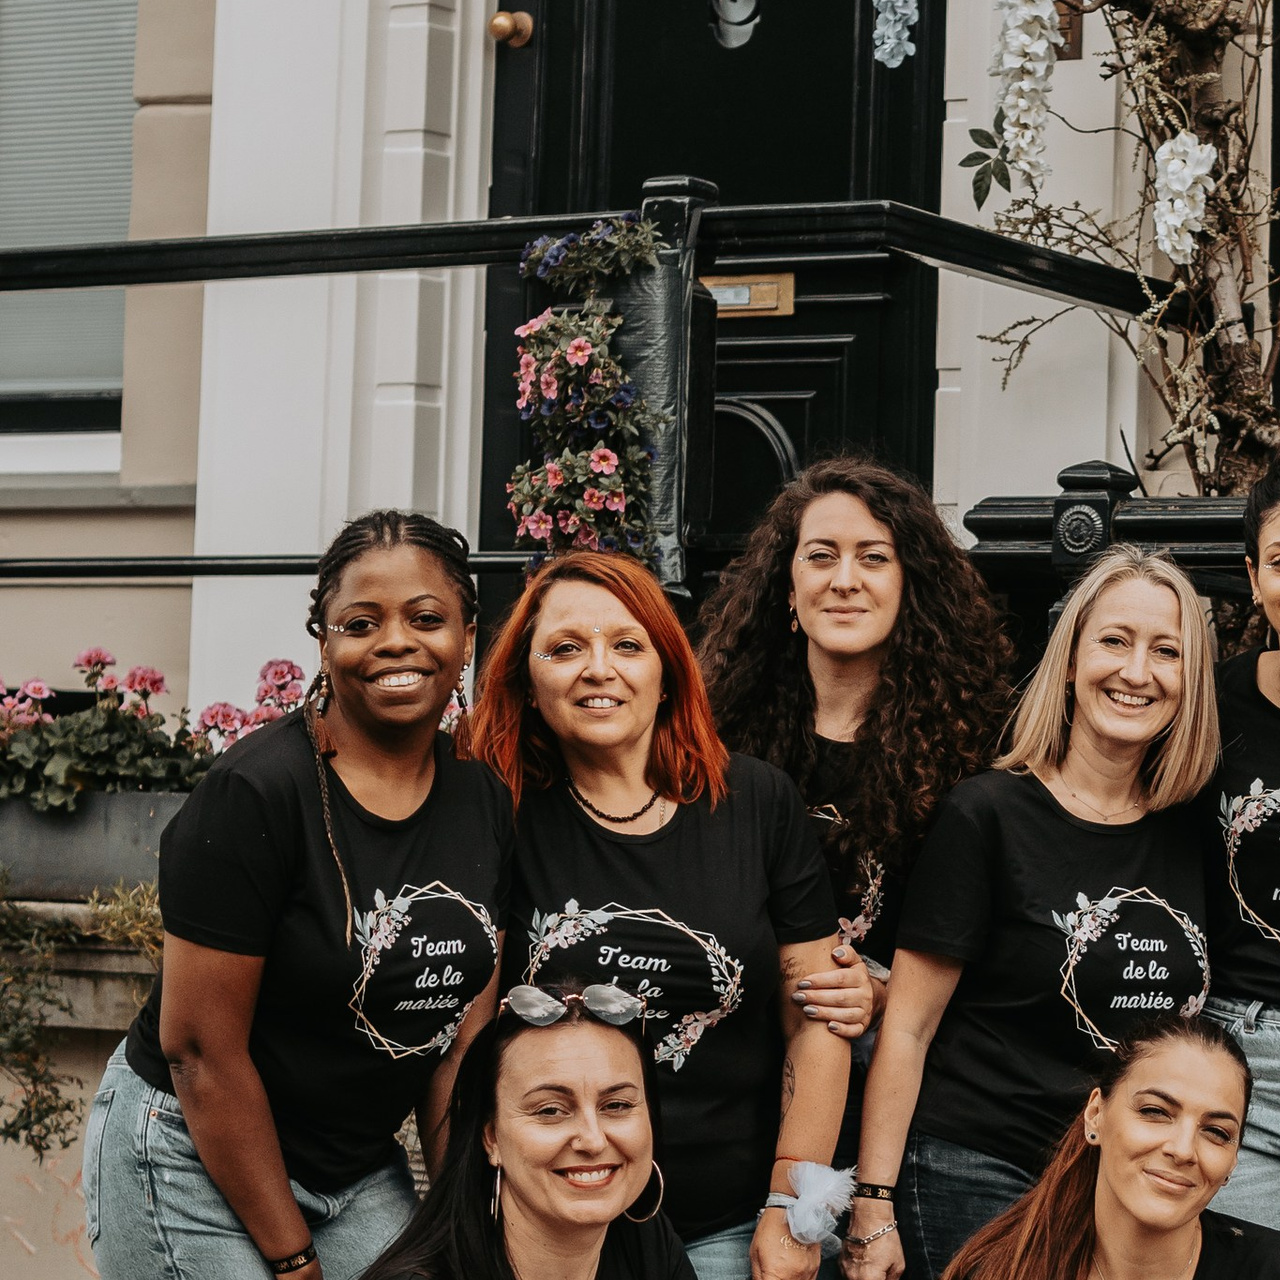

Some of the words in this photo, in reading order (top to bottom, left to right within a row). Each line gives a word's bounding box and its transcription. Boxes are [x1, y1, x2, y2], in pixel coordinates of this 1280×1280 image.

[410, 934, 466, 958] Team
[1114, 932, 1168, 952] Team
[597, 945, 672, 972] Team
[415, 966, 440, 989] de
[442, 964, 464, 986] la
[1122, 959, 1147, 979] de
[1148, 959, 1170, 979] la
[394, 993, 459, 1011] mariée
[1109, 991, 1175, 1009] mariée
